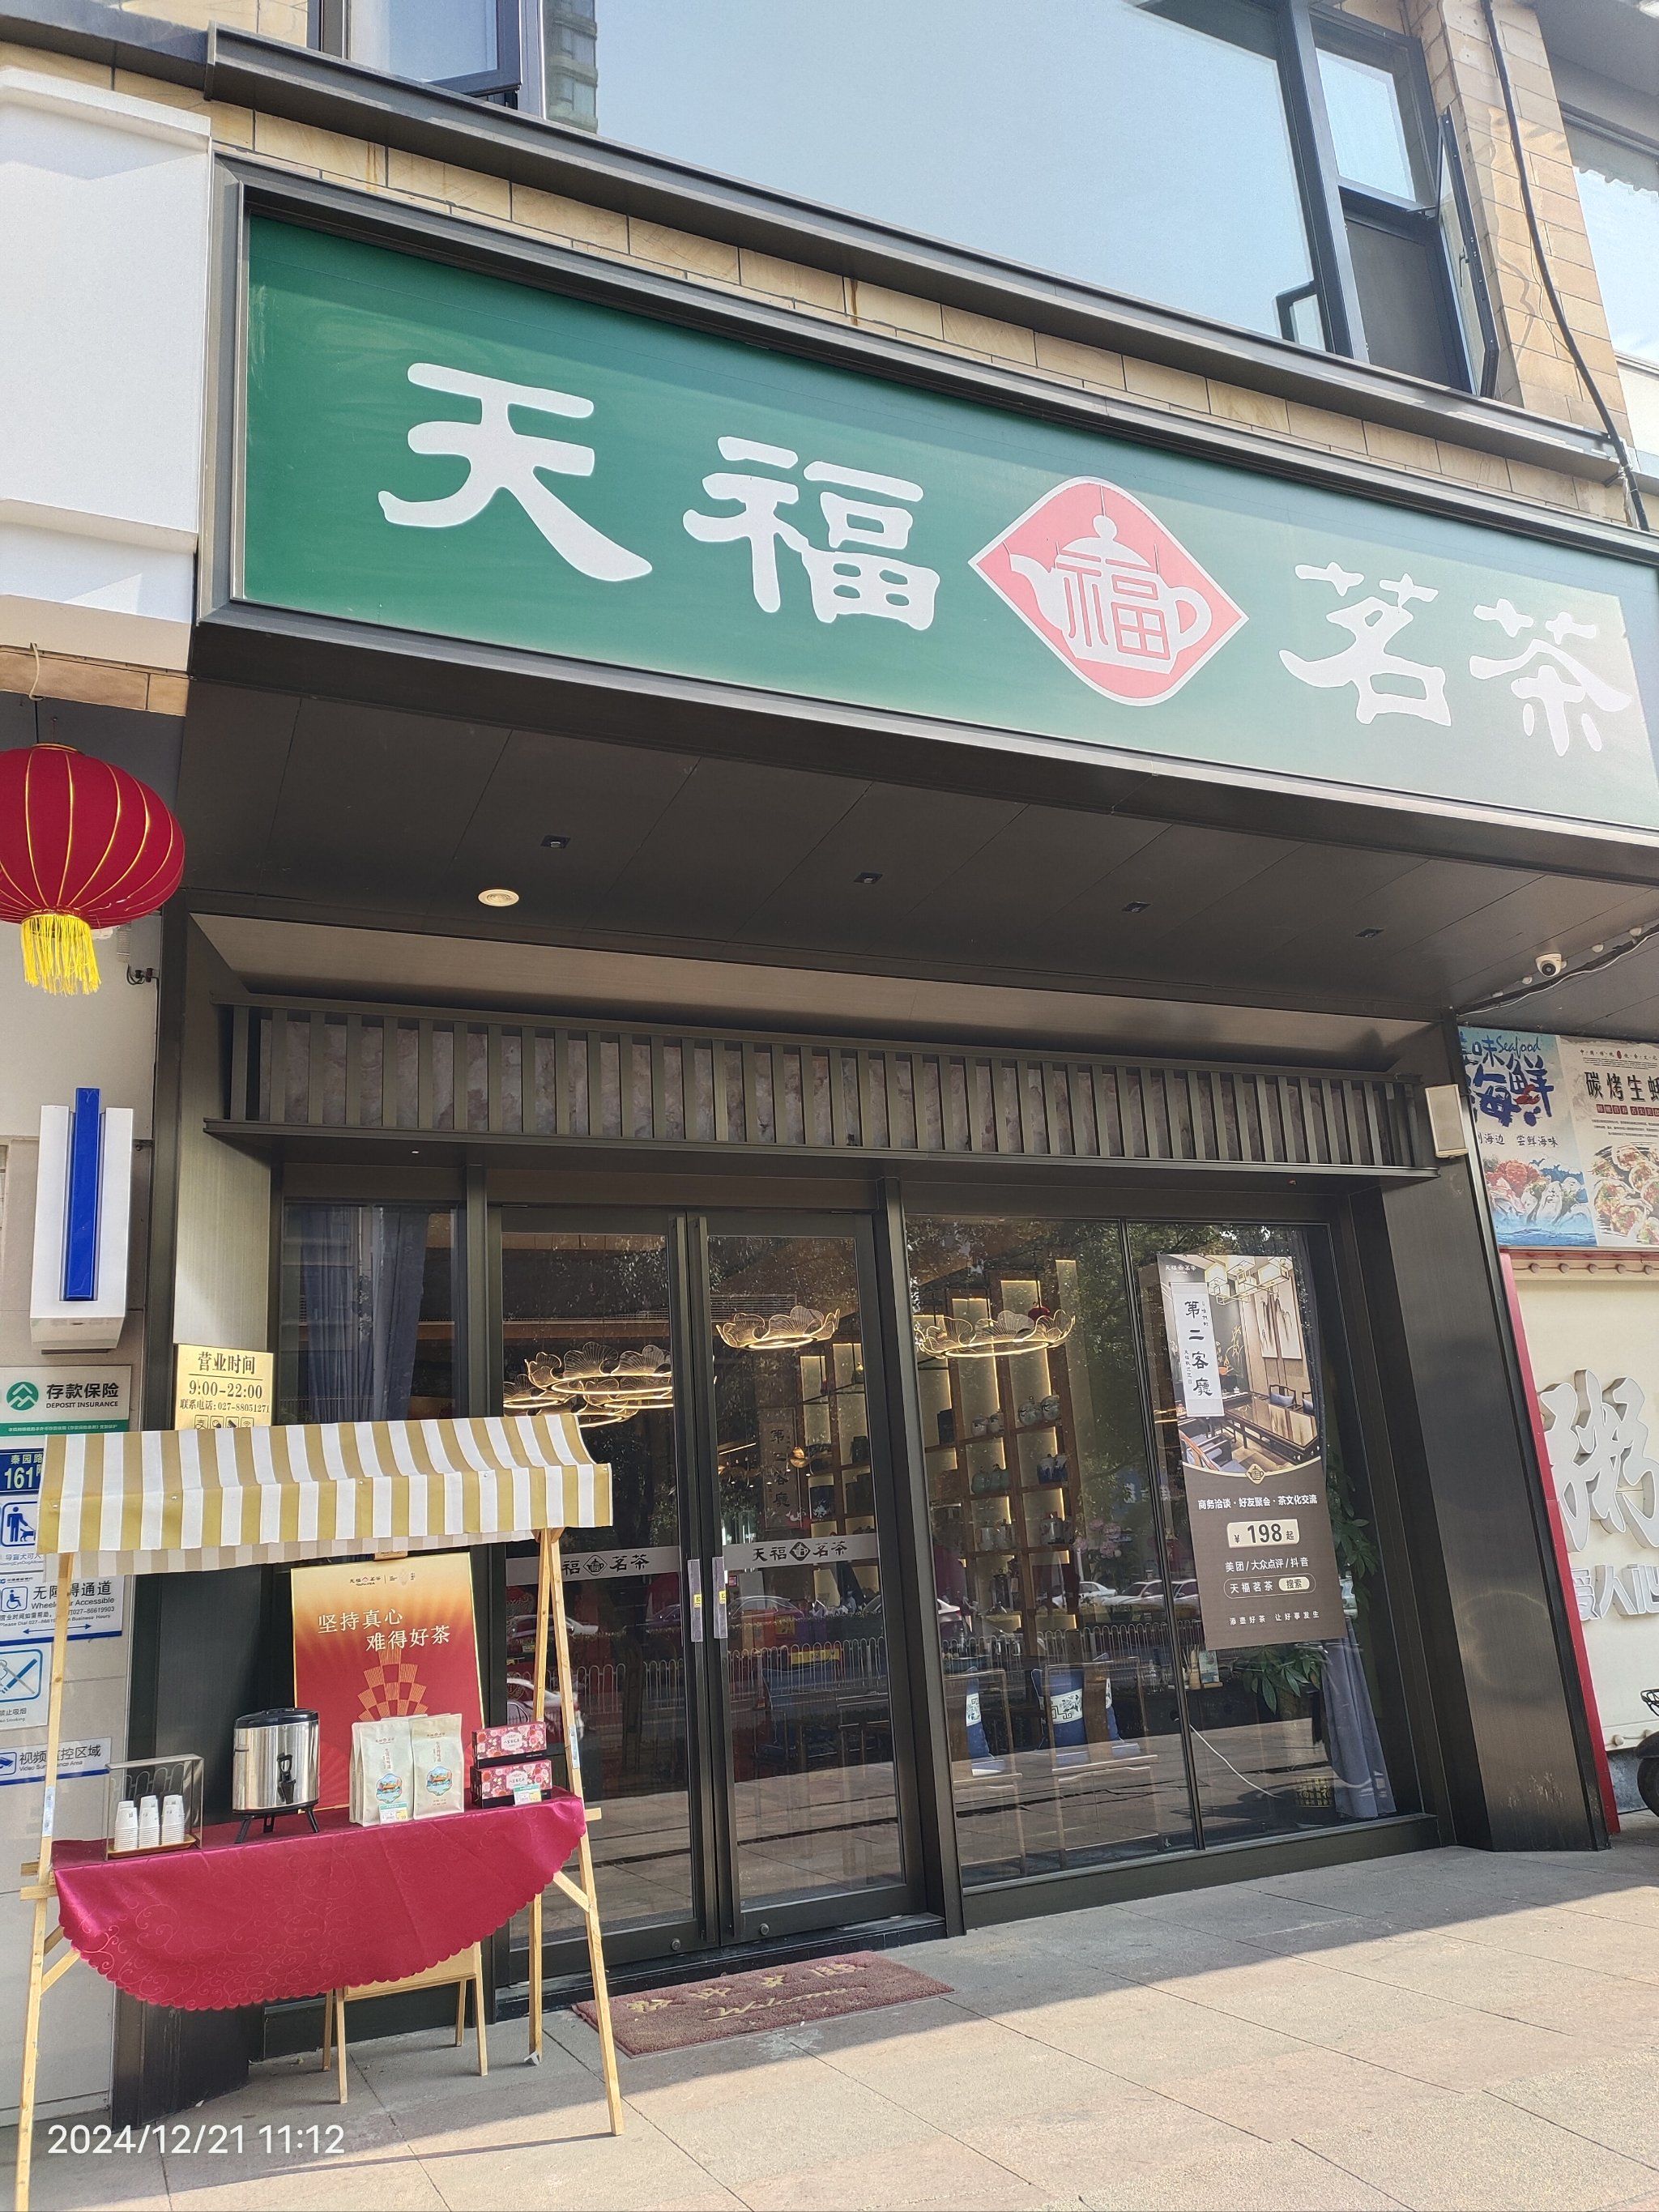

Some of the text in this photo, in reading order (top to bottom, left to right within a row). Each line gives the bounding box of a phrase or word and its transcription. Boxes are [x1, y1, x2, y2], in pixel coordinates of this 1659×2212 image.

[377, 362, 940, 631] 天福
[1278, 562, 1632, 757] 茗茶
[1495, 1035, 1542, 1059] Seafood
[198, 1351, 255, 1375] 营业时间
[46, 1382, 119, 1400] 存款保险
[189, 1379, 262, 1399] 9:00-22:00
[753, 1541, 847, 1562] 天福 茗茶
[610, 1554, 649, 1572] 茗茶
[1230, 1581, 1273, 1594] 天福茗茶
[75, 1596, 115, 1606] Accessible
[318, 1608, 403, 1634] 坚持真心
[365, 1625, 451, 1652] 难得好茶
